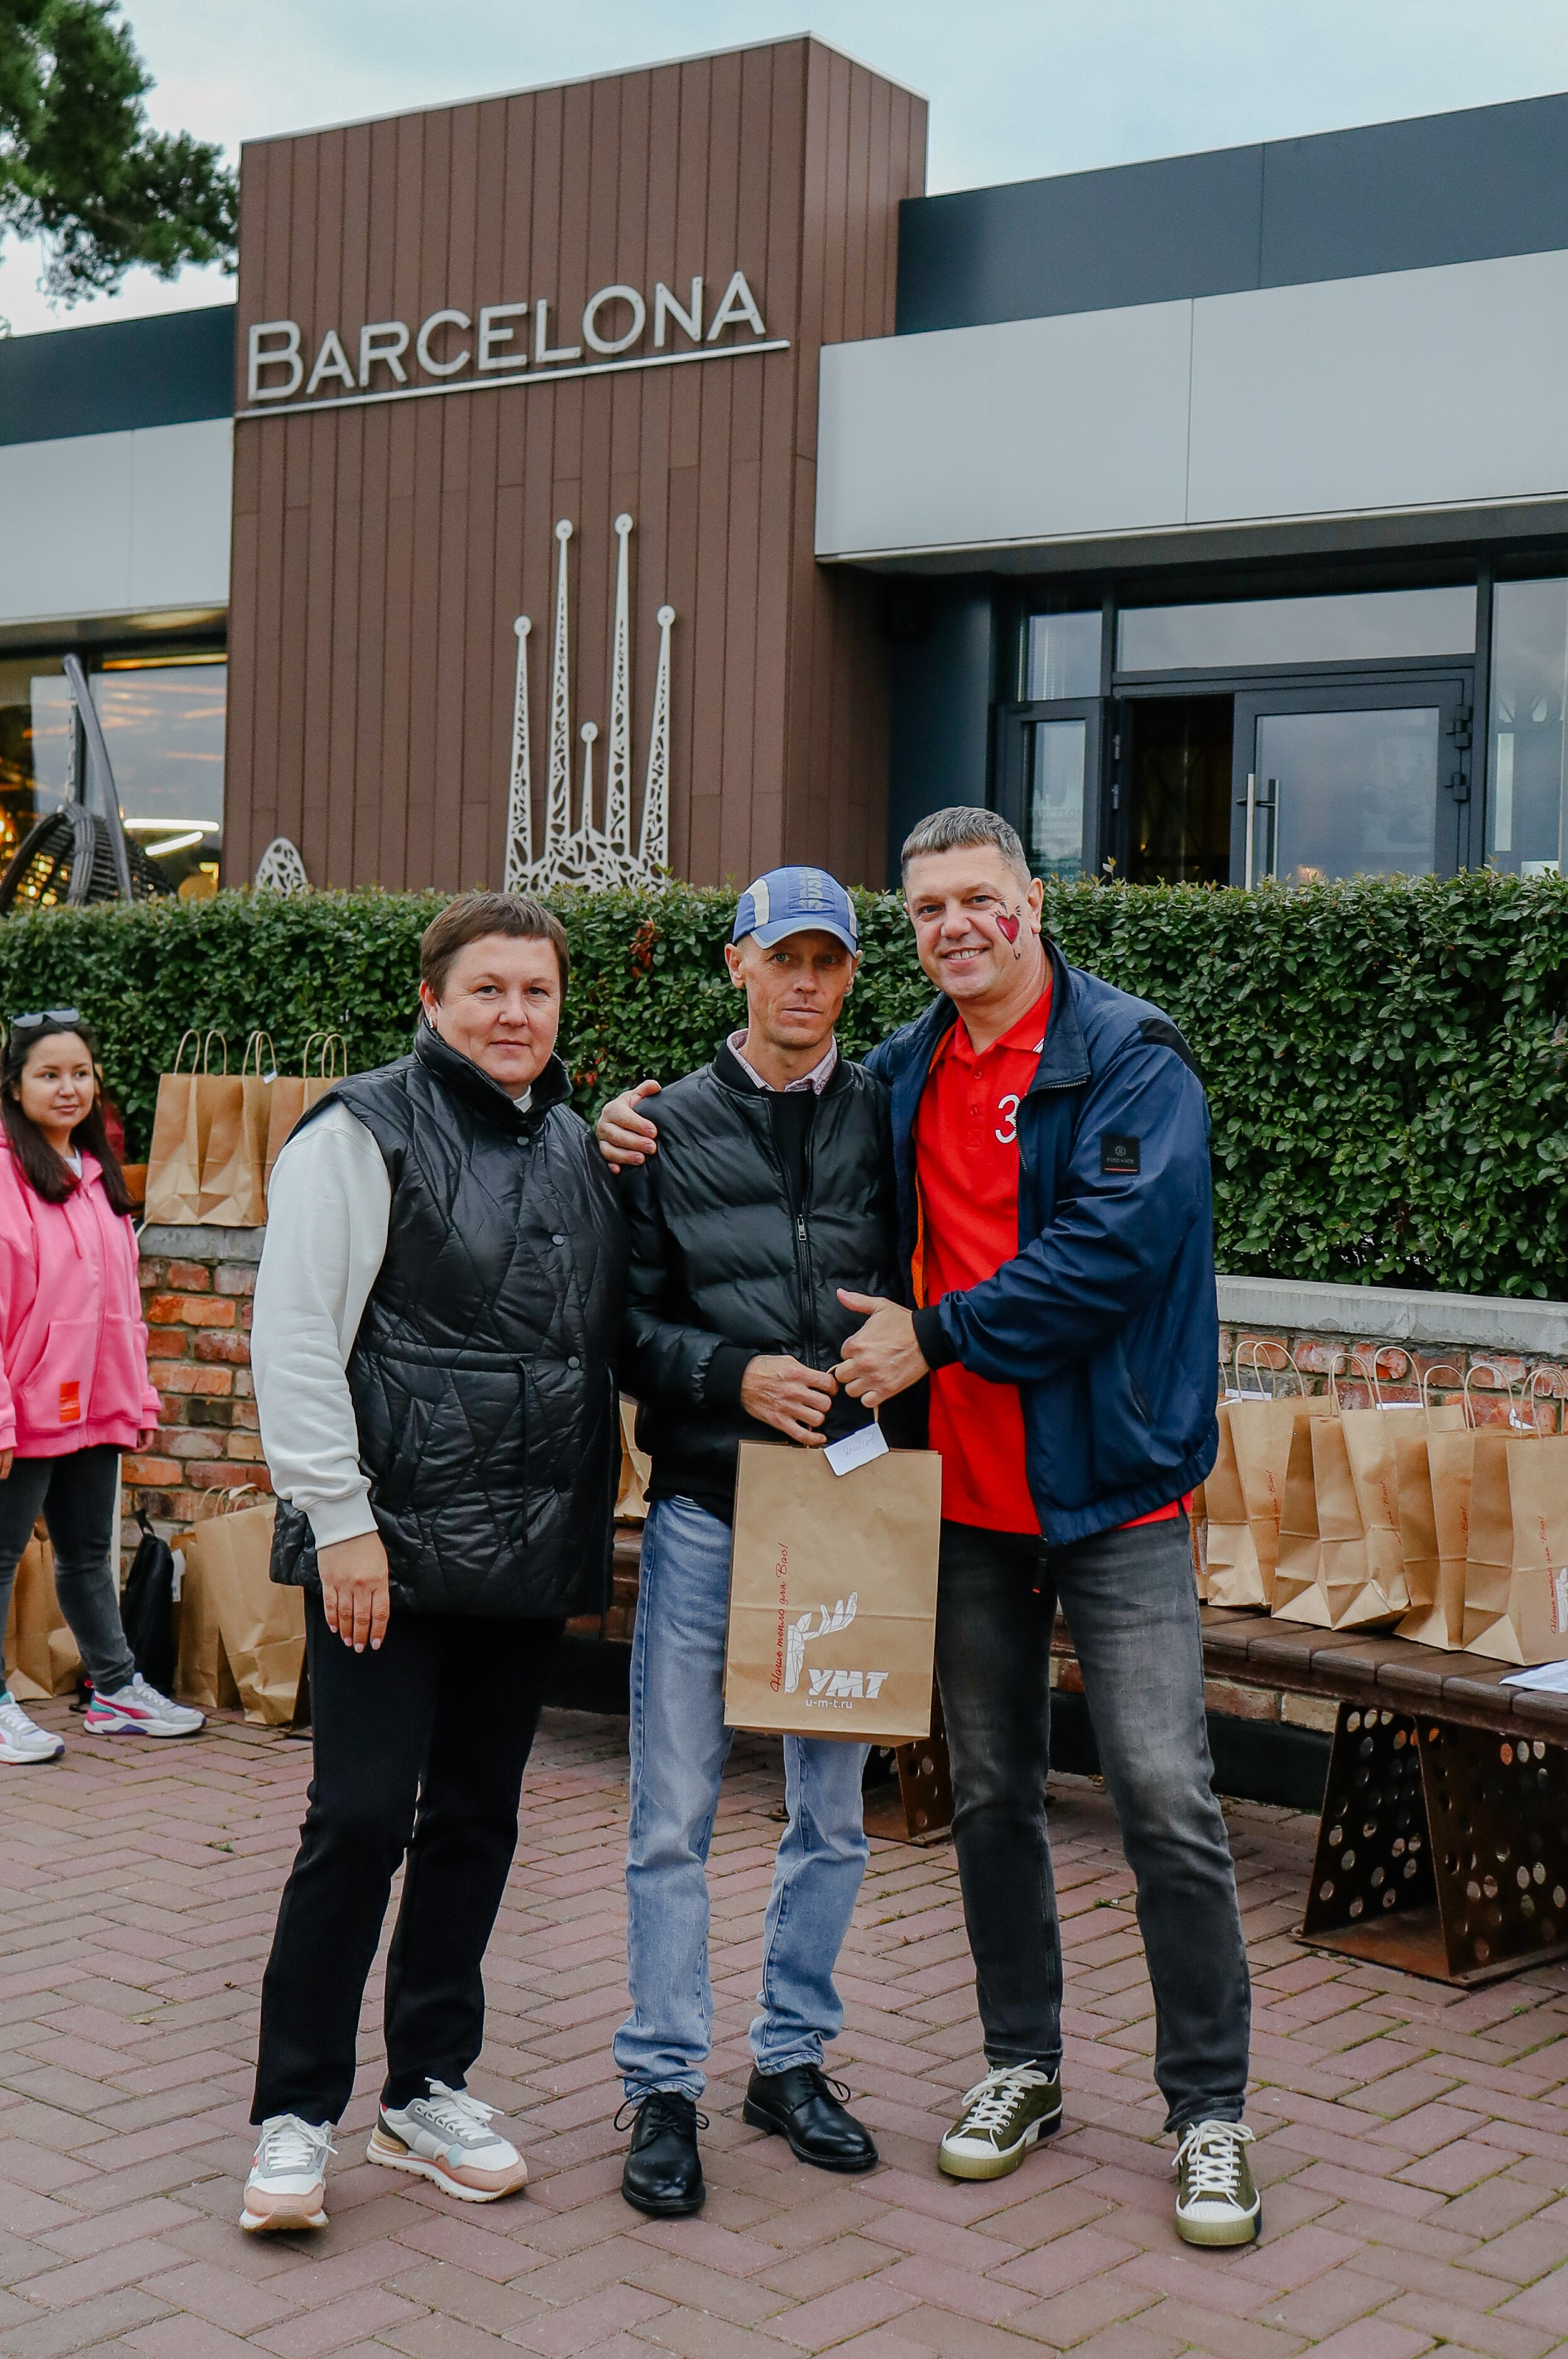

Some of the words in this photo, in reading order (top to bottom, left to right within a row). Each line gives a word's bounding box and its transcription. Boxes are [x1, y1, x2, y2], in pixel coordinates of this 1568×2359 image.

[248, 270, 767, 402] BARCELONA
[995, 1094, 1020, 1144] 3
[775, 1541, 789, 1578] Вас!
[779, 1581, 789, 1606] для
[776, 1608, 786, 1648] тепло
[770, 1651, 784, 1694] Наше
[807, 1667, 890, 1700] УМТ
[805, 1698, 853, 1710] u-m-t.ru
